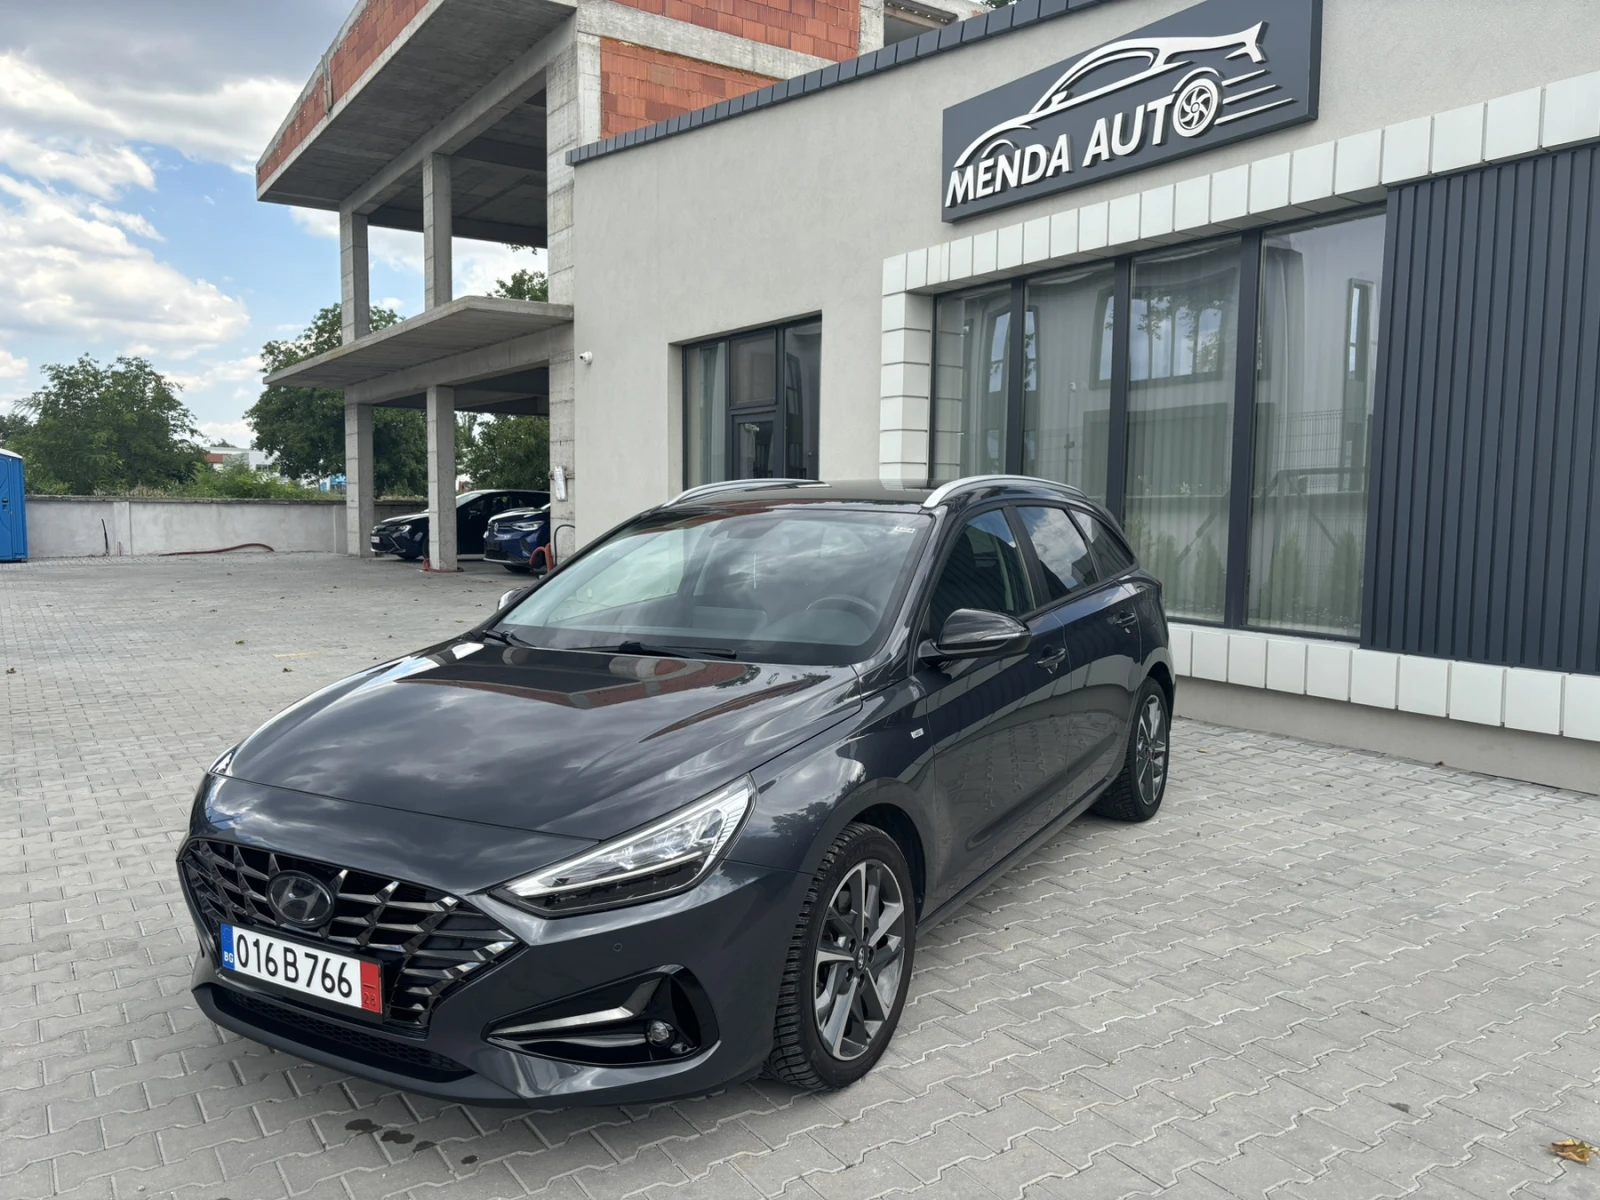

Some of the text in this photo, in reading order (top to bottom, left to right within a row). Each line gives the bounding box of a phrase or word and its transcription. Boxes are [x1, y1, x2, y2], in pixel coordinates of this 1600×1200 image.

[945, 77, 1222, 208] MENDA AUTO
[223, 950, 234, 963] BG
